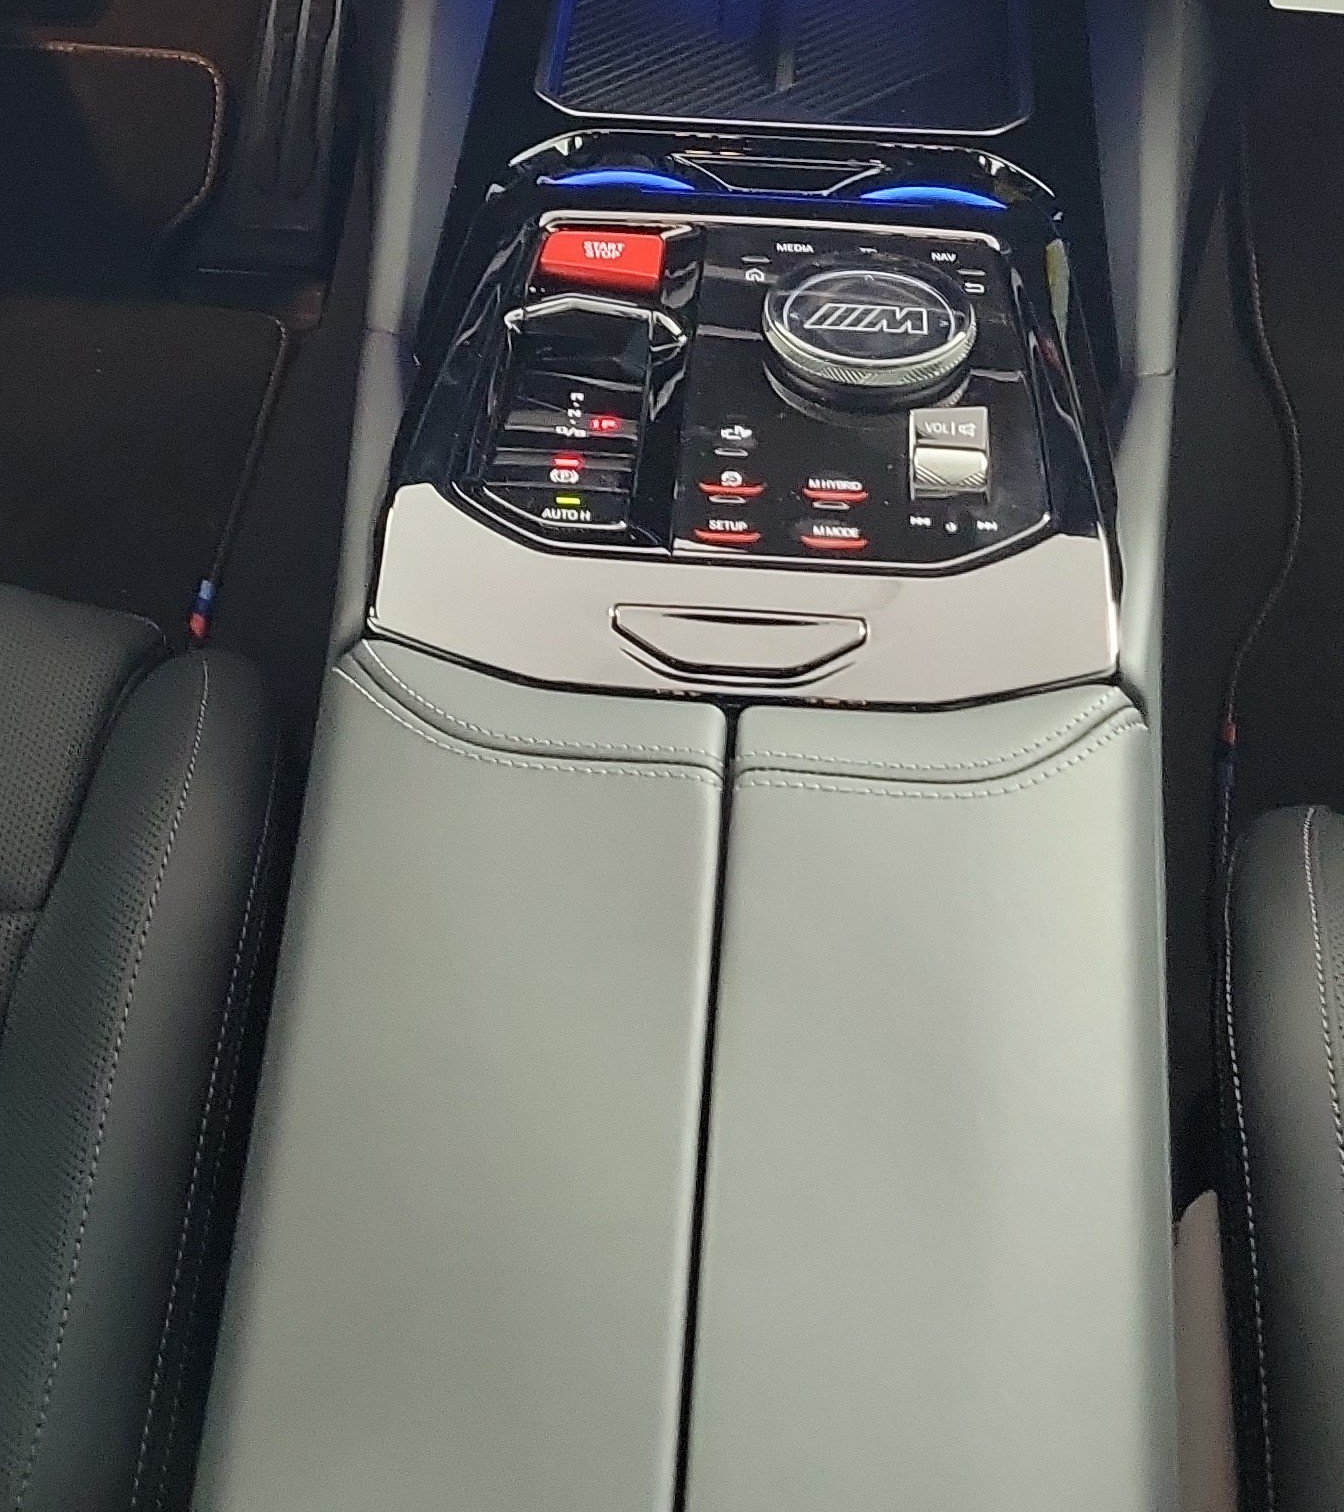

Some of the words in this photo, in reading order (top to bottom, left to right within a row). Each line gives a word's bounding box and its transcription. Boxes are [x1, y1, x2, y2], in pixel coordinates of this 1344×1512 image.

[583, 240, 625, 252] START
[776, 243, 814, 253] MEDIA
[584, 249, 621, 260] STOP
[931, 252, 957, 263] NAV
[924, 421, 950, 435] VOL
[541, 507, 579, 521] AUTO
[579, 509, 592, 521] H
[709, 519, 748, 531] SETUP
[825, 526, 861, 539] MODE
